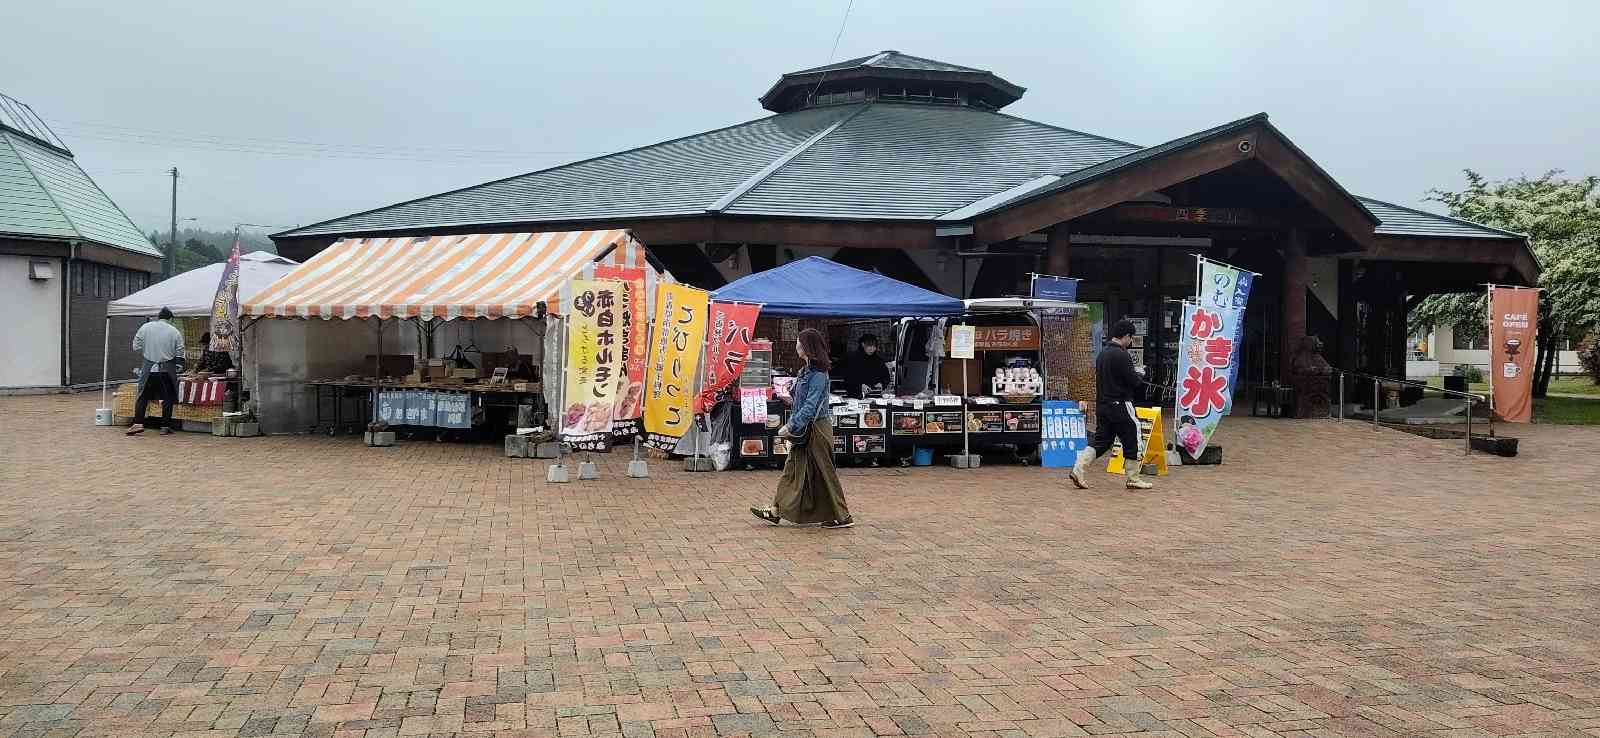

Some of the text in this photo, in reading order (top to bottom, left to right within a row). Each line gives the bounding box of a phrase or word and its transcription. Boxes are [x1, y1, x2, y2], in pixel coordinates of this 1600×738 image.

[593, 289, 614, 398] 赤白ホルモン
[1181, 308, 1233, 417] かき氷
